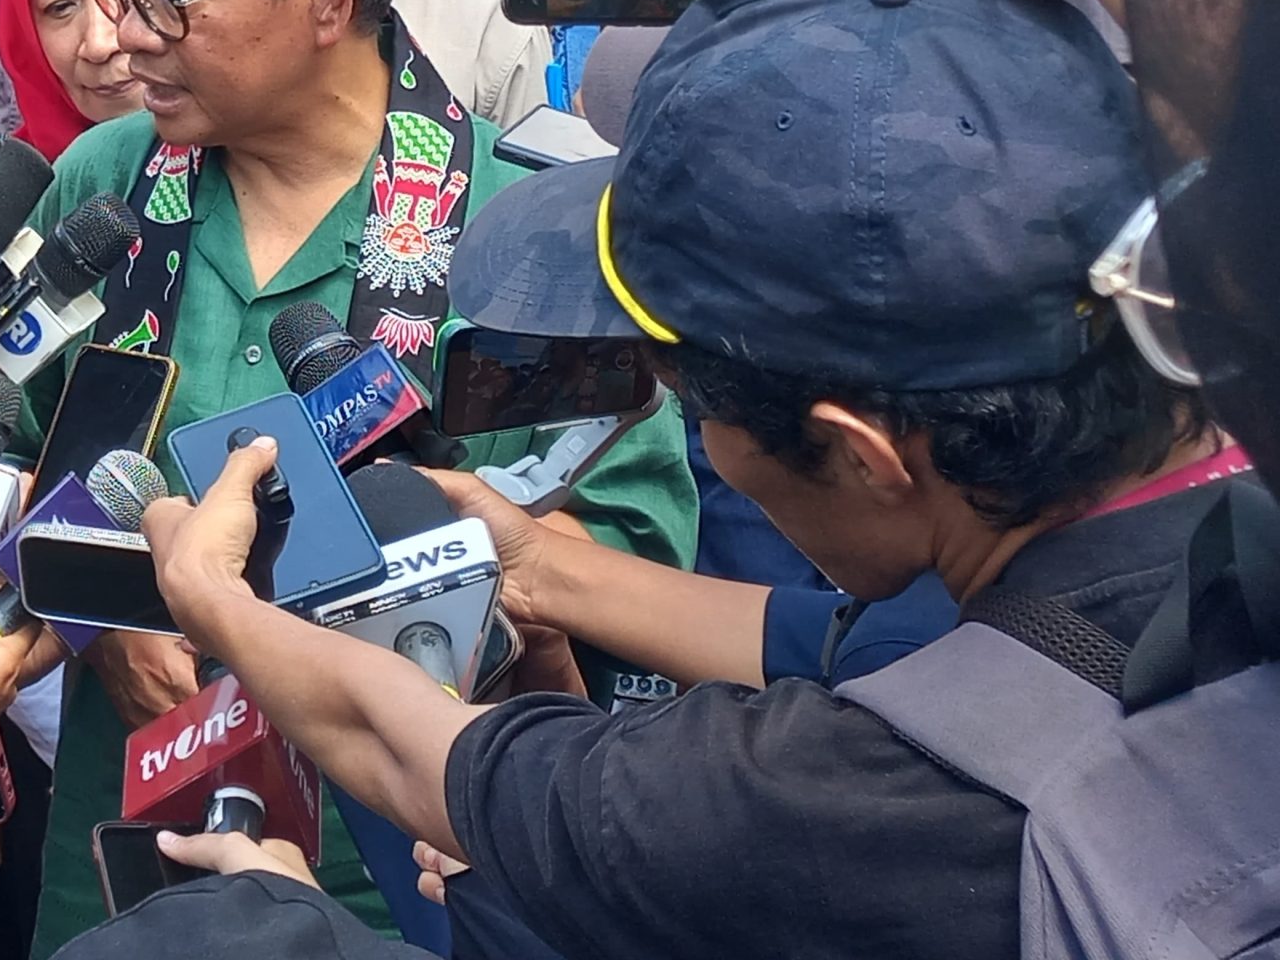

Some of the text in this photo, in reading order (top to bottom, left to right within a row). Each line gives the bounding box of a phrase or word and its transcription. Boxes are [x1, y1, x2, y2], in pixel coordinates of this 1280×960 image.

[6, 316, 36, 349] RI
[314, 383, 378, 438] OMPAS
[386, 539, 468, 581] ews
[139, 698, 249, 782] tvOne
